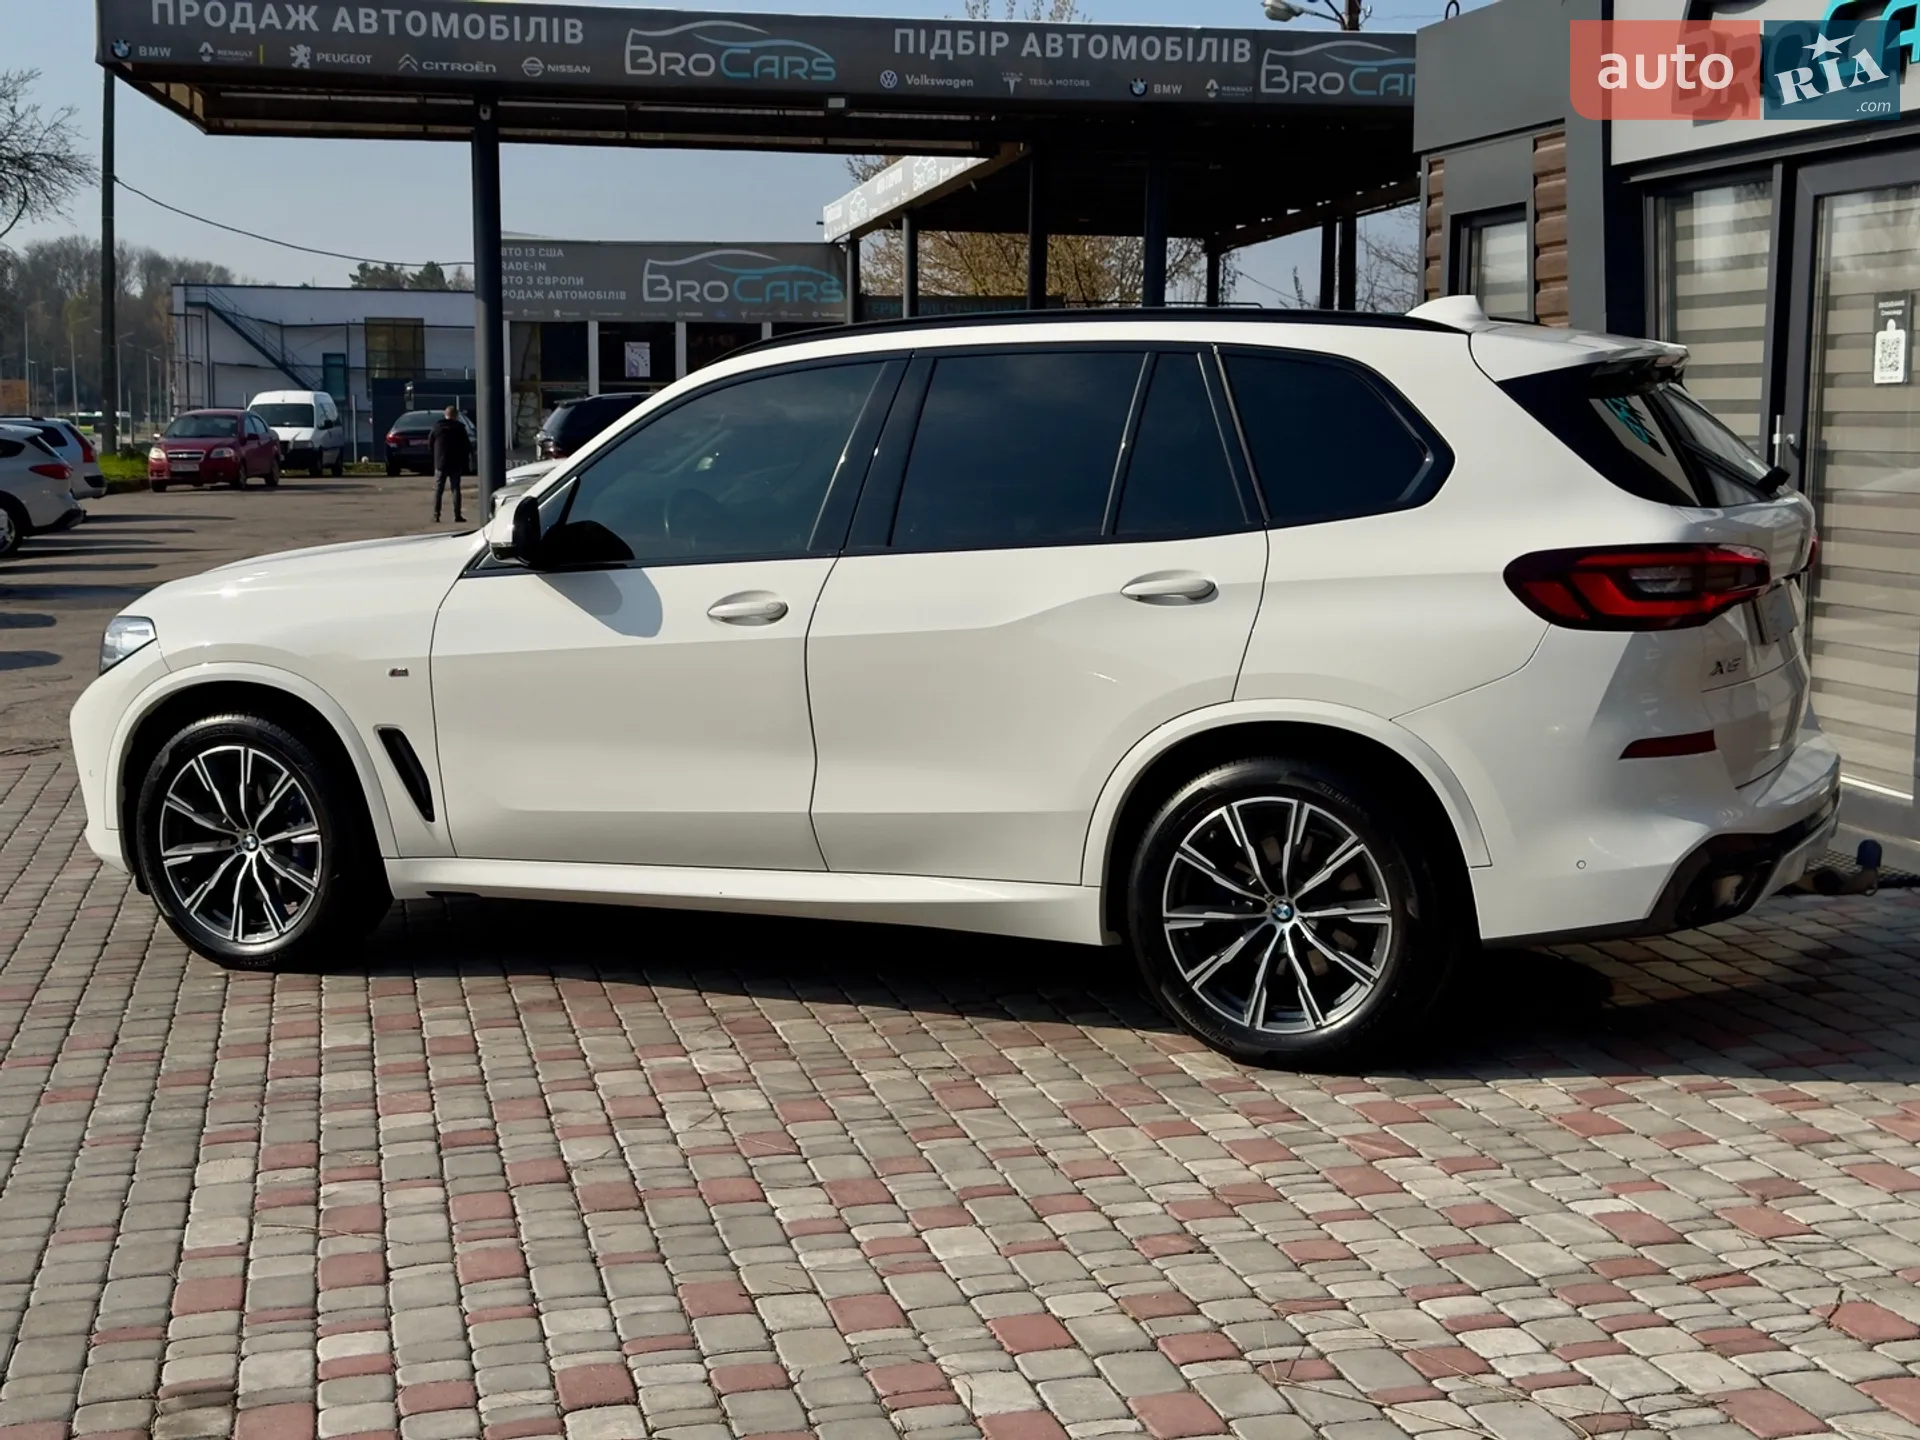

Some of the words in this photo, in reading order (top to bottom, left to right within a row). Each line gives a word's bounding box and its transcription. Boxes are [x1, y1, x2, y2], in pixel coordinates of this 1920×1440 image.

[151, 0, 320, 34] ПРОДАЖ
[332, 6, 584, 44] АВТОМОБІЛІВ
[894, 28, 1009, 60] ПІДБІР
[1020, 33, 1251, 63] АВТОМОБІЛІВ
[138, 46, 171, 57] BMW
[217, 49, 253, 58] RENAULT
[316, 52, 372, 65] PEUGEOT
[547, 64, 591, 74] NISSAN
[905, 74, 974, 88] Volkswagen
[1029, 78, 1054, 86] TESLA
[1056, 79, 1090, 87] MOTORS
[1154, 83, 1182, 94] BMW
[501, 247, 522, 257] ВТО
[538, 248, 564, 258] США
[501, 261, 546, 271] RADE-IN
[501, 275, 523, 285] ВТО
[537, 276, 584, 286] ЄВРОПИ
[502, 290, 545, 299] РОДАЖ
[547, 290, 627, 300] АВТОМОБІЛІВ
